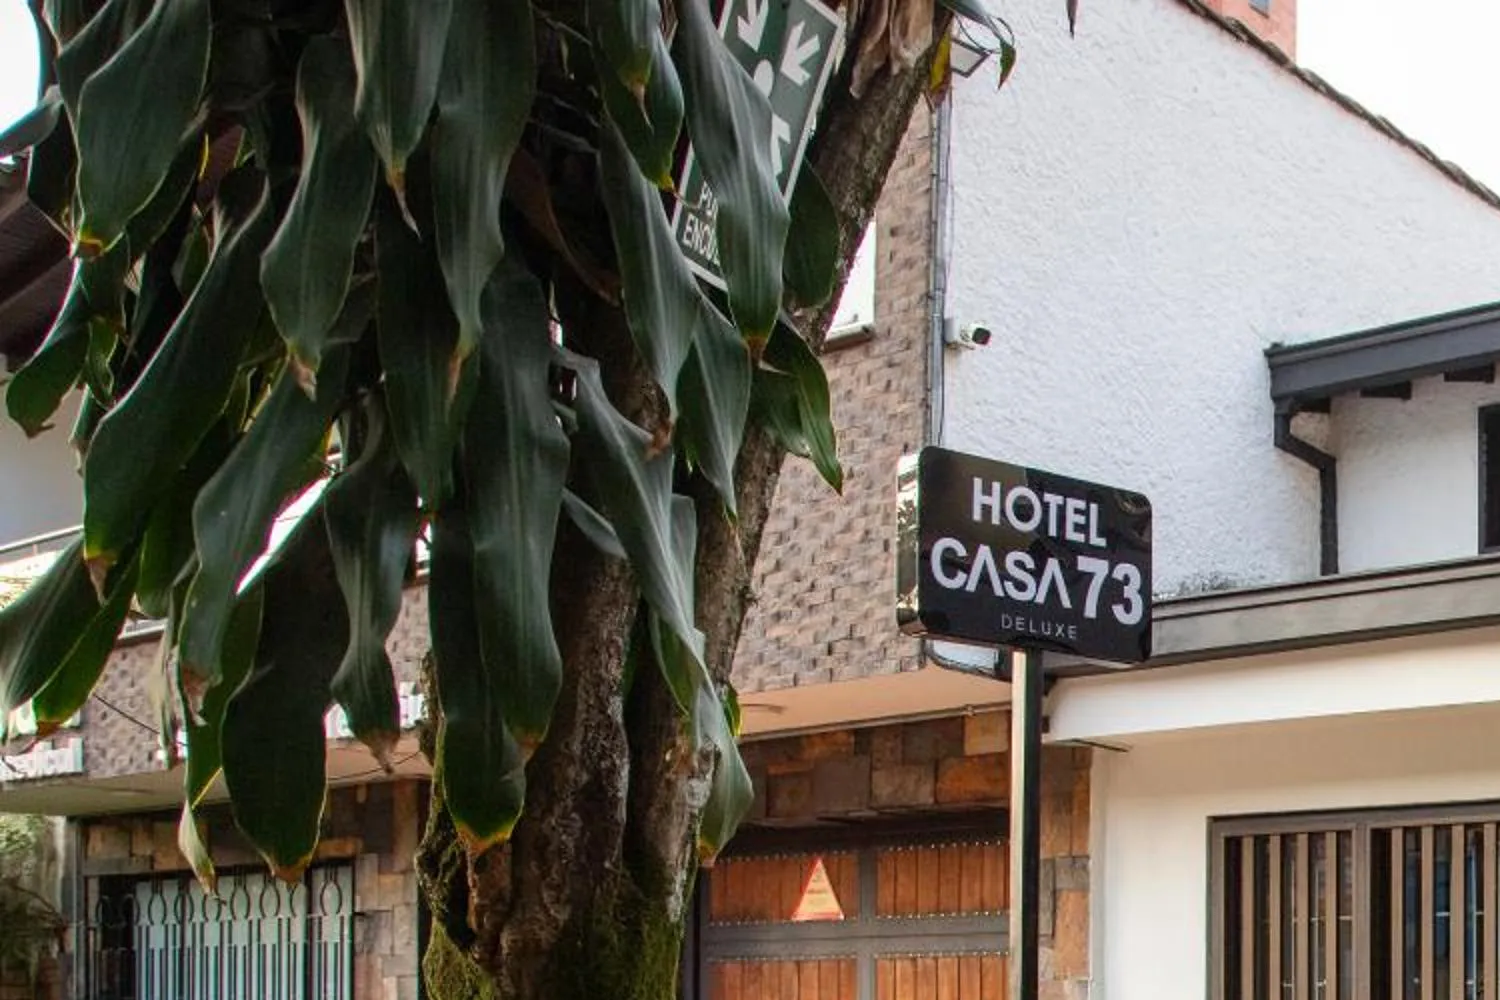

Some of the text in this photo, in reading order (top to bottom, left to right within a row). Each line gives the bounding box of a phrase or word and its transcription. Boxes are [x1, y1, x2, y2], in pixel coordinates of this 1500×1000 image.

[972, 477, 1107, 547] HOTEL
[930, 537, 1144, 625] CASA 73
[1001, 613, 1078, 640] DELUXE
